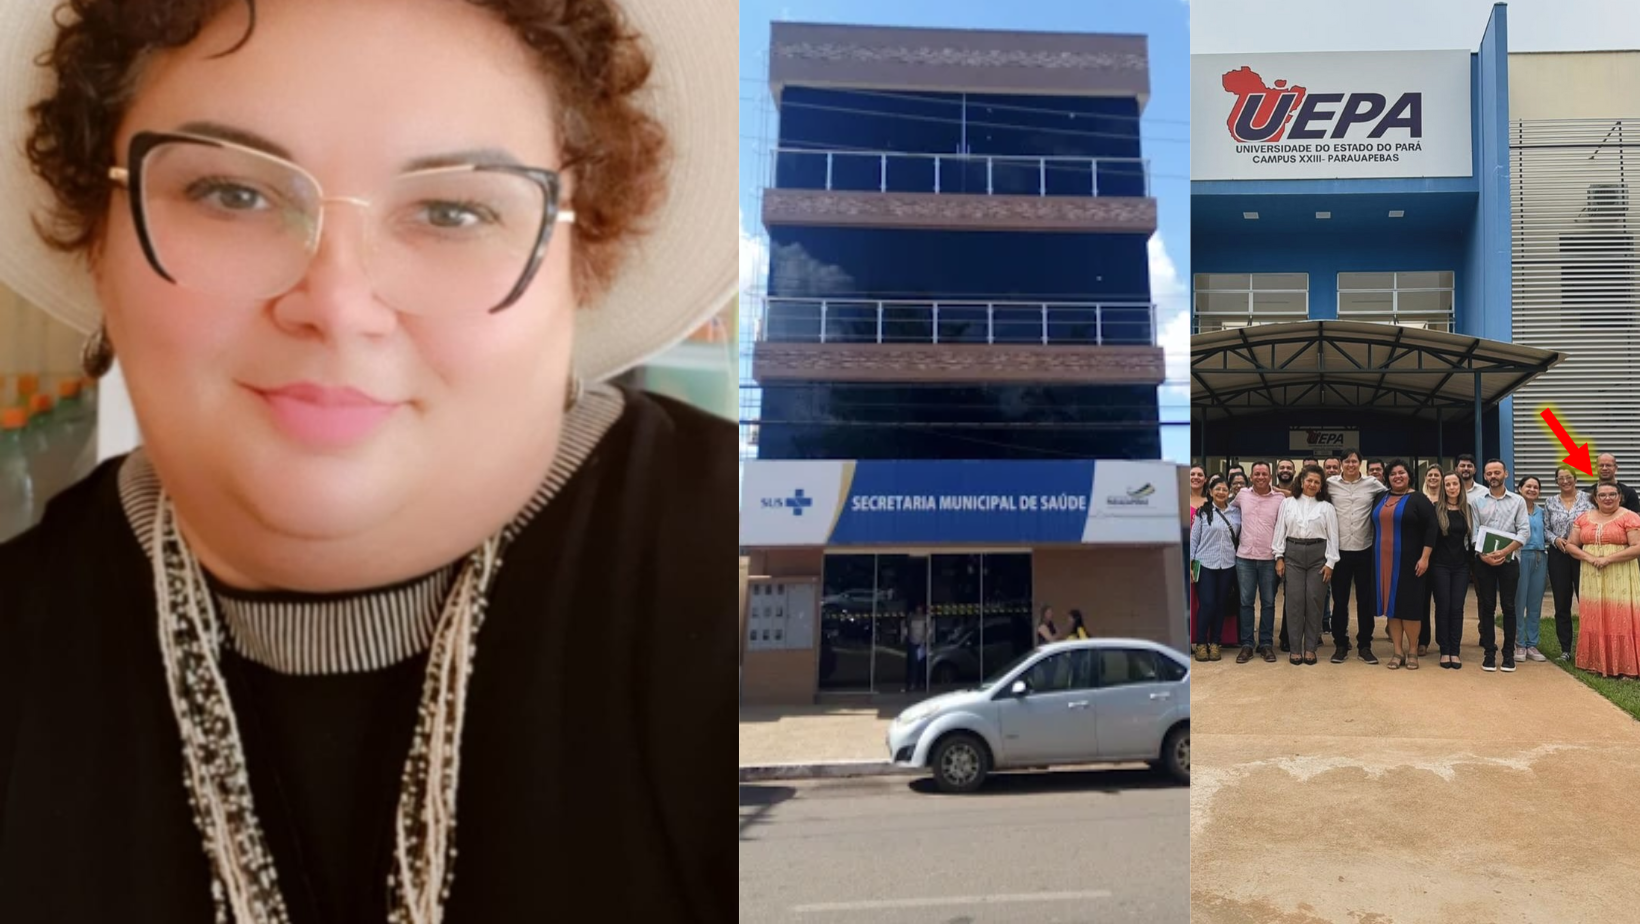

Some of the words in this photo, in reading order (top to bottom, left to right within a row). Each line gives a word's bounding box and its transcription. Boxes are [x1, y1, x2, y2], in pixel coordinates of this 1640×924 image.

[1234, 92, 1423, 141] UEPA
[1235, 144, 1313, 154] UNIVERSIDADE
[1315, 144, 1330, 153] DO
[1333, 143, 1374, 152] ESTADO
[1376, 143, 1392, 152] DO
[1395, 141, 1422, 152] PARÁ
[1252, 155, 1297, 164] CAMPUS
[1327, 153, 1400, 163] PARAUAPEBAS
[1307, 433, 1344, 445] UEPA
[760, 498, 783, 508] SUS
[851, 495, 936, 512] SECRETARIA
[938, 495, 1017, 511] MUNICIPAL
[1020, 495, 1037, 511] DE
[1040, 493, 1087, 511] SAÚDE
